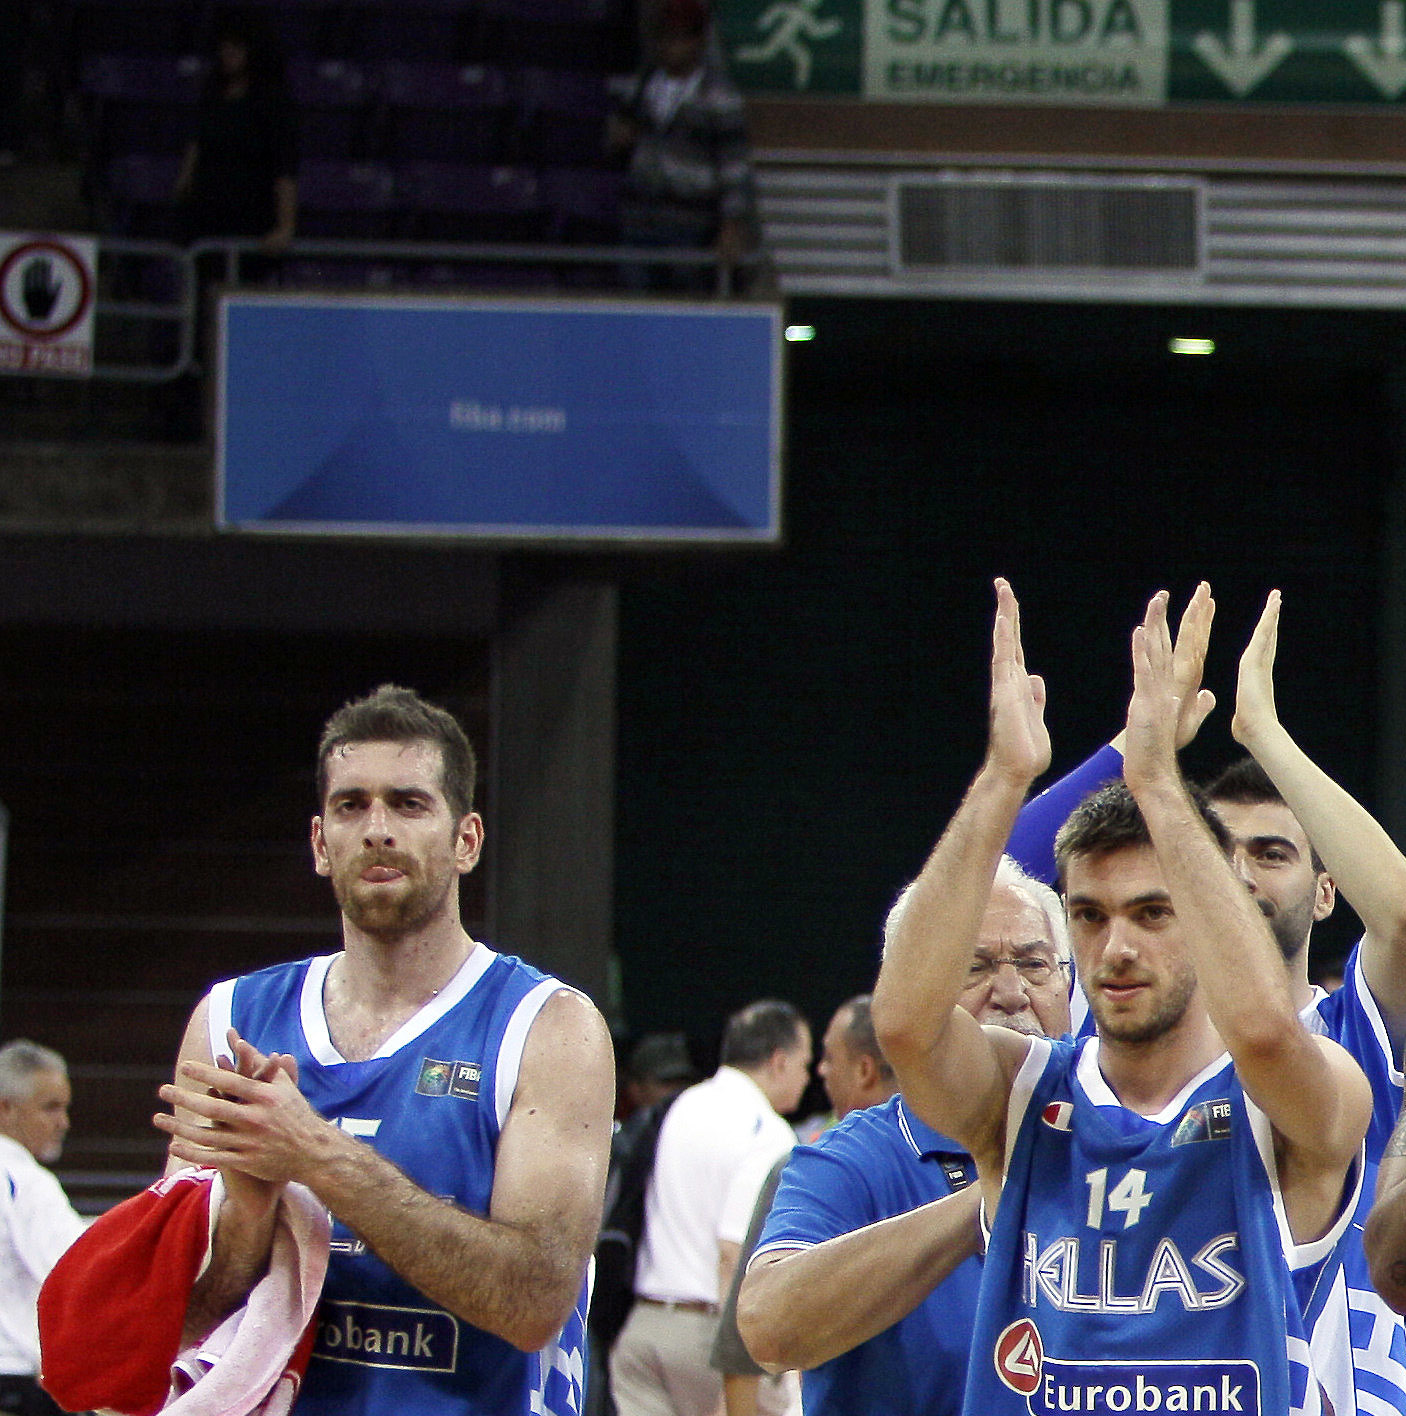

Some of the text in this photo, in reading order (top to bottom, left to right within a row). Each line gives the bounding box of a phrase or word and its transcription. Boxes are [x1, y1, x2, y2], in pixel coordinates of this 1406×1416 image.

[887, 0, 1144, 46] SALIDA
[887, 61, 1141, 92] EMERGENCIA
[1085, 1167, 1154, 1231] 14
[1022, 1230, 1246, 1315] HELLAS
[1043, 1374, 1244, 1412] Eurobank
